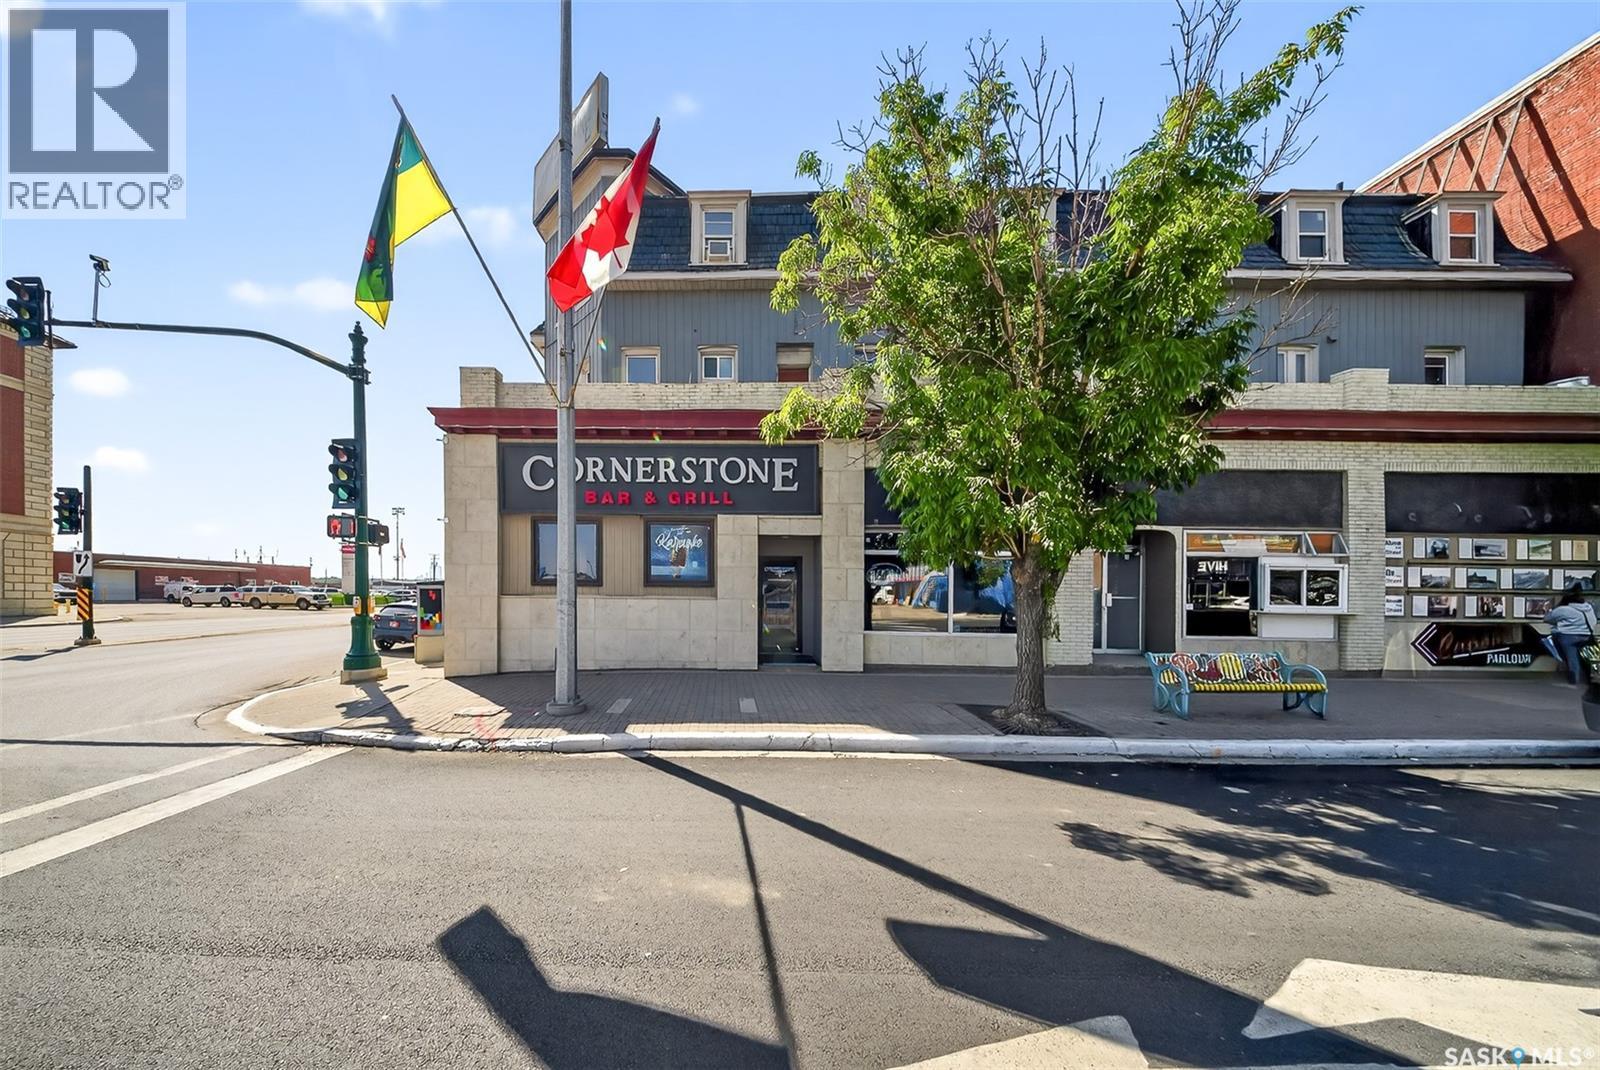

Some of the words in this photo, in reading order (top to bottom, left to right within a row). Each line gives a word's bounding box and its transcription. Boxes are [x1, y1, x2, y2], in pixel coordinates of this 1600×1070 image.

[584, 491, 631, 505] BAR
[644, 491, 657, 505] &
[668, 491, 734, 506] GRILL
